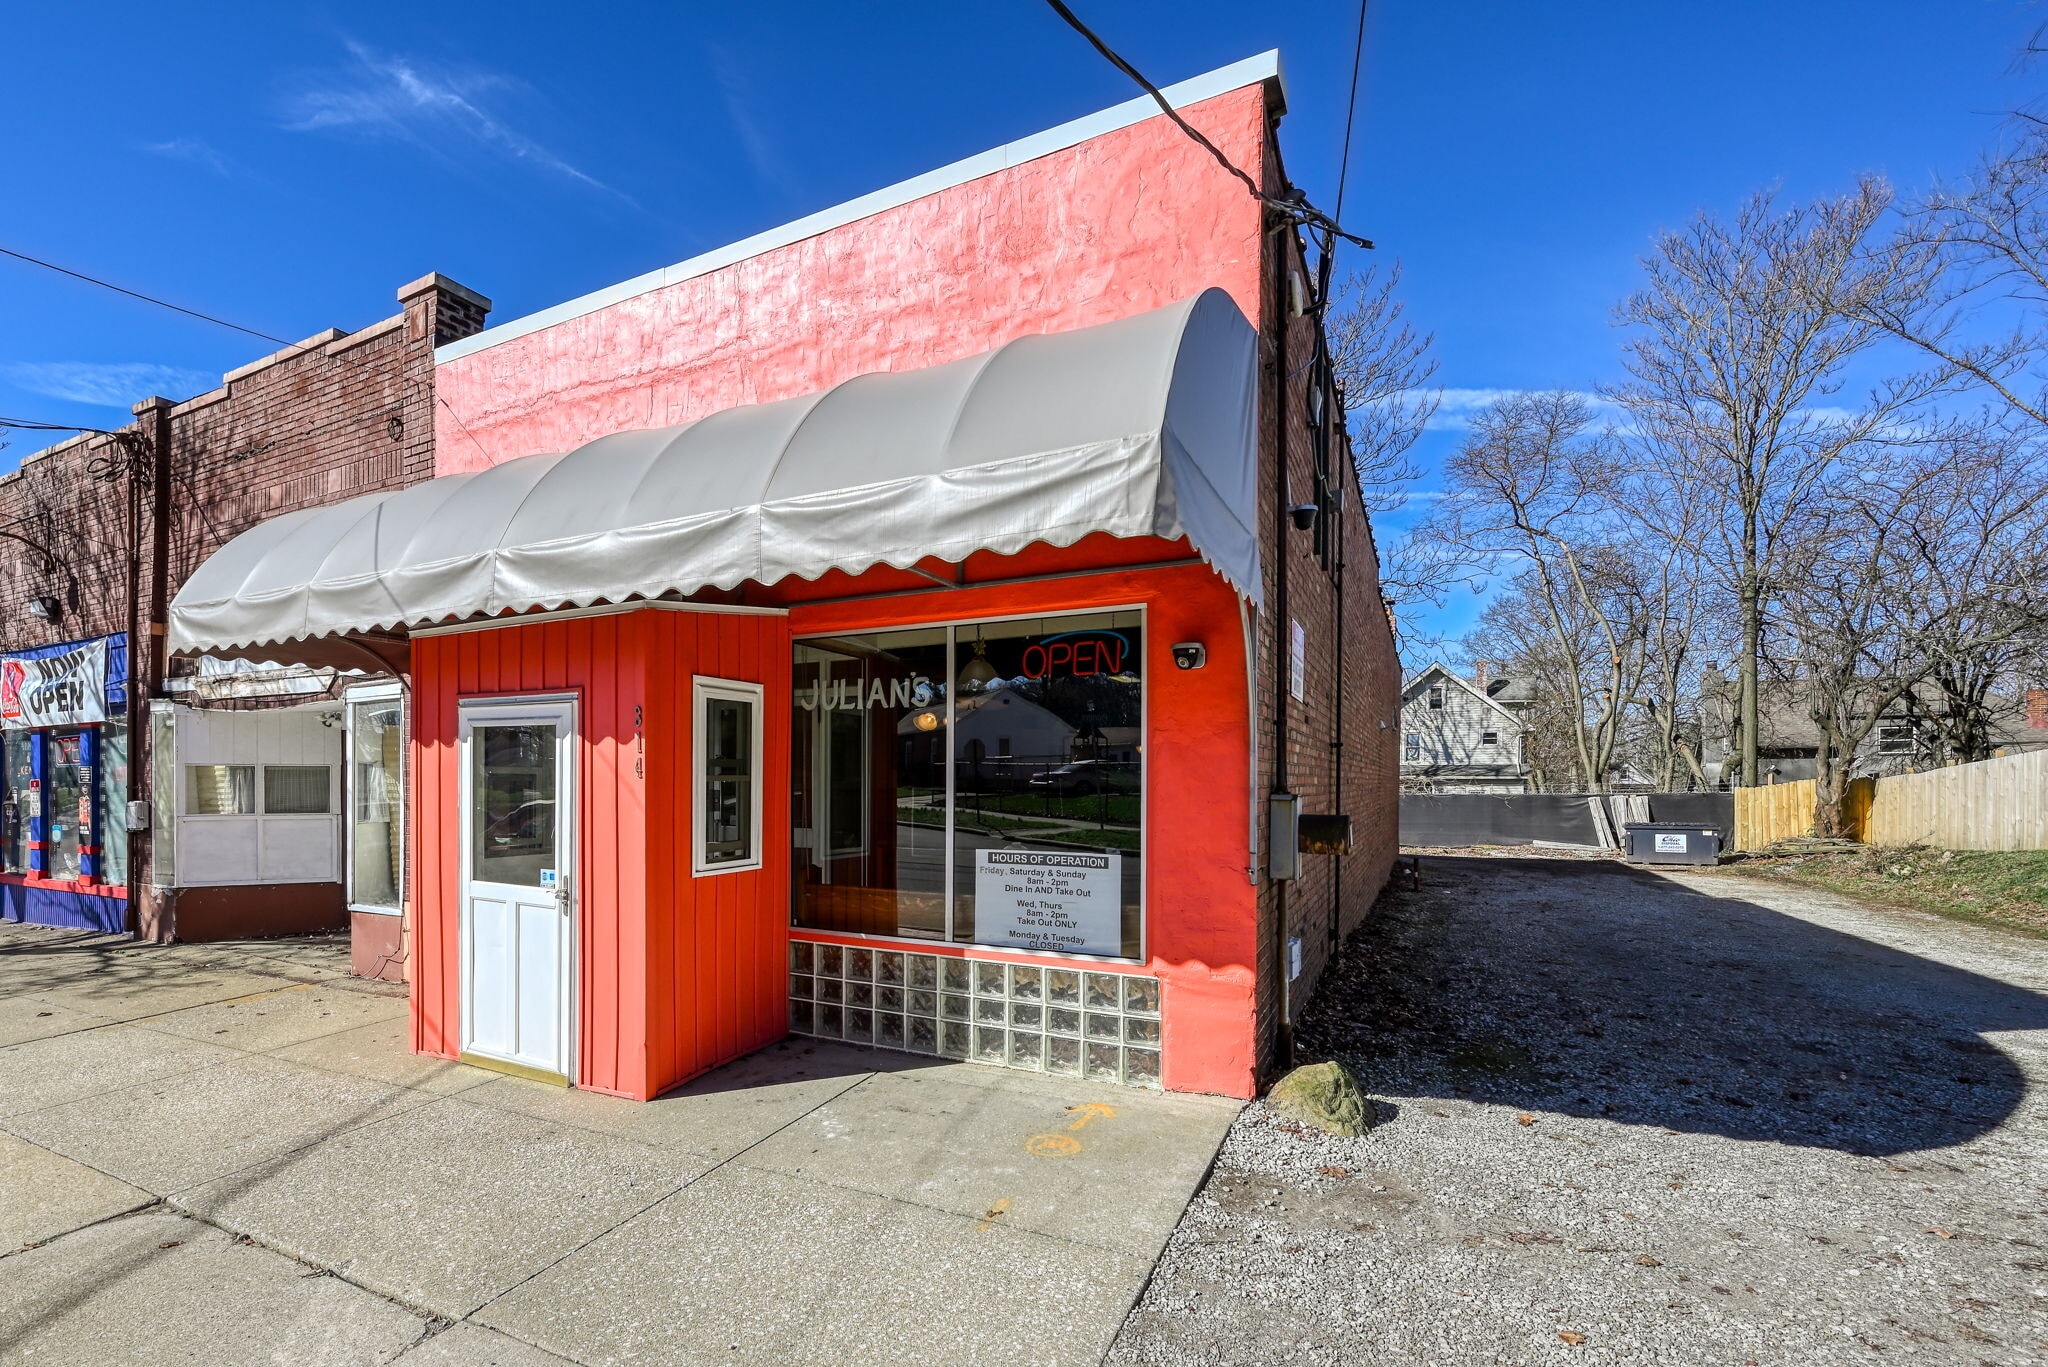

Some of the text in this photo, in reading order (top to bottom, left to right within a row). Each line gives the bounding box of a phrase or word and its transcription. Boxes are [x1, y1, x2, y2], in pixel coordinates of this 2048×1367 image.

[1022, 639, 1122, 680] OPEN
[36, 650, 86, 685] NOW
[799, 671, 931, 711] JULIAN'S
[29, 680, 85, 716] OPEN
[56, 737, 80, 764] OPE
[992, 853, 1105, 868] HOURS OF OPERATION
[1009, 867, 1045, 878] Saturday
[1047, 869, 1054, 877] &
[1055, 870, 1087, 880] Sunday
[1026, 877, 1044, 885] 8am
[1050, 878, 1069, 887] 2pm
[1004, 885, 1091, 897] Dine In AND Take Out
[1016, 900, 1063, 910] Wed, Thurs
[1026, 909, 1044, 917] 8am
[1050, 911, 1068, 919] 2pm
[1017, 917, 1078, 929] Take Out ONLY
[1008, 930, 1085, 944] Monday & Tuesday
[1028, 941, 1065, 950] CLOSED
